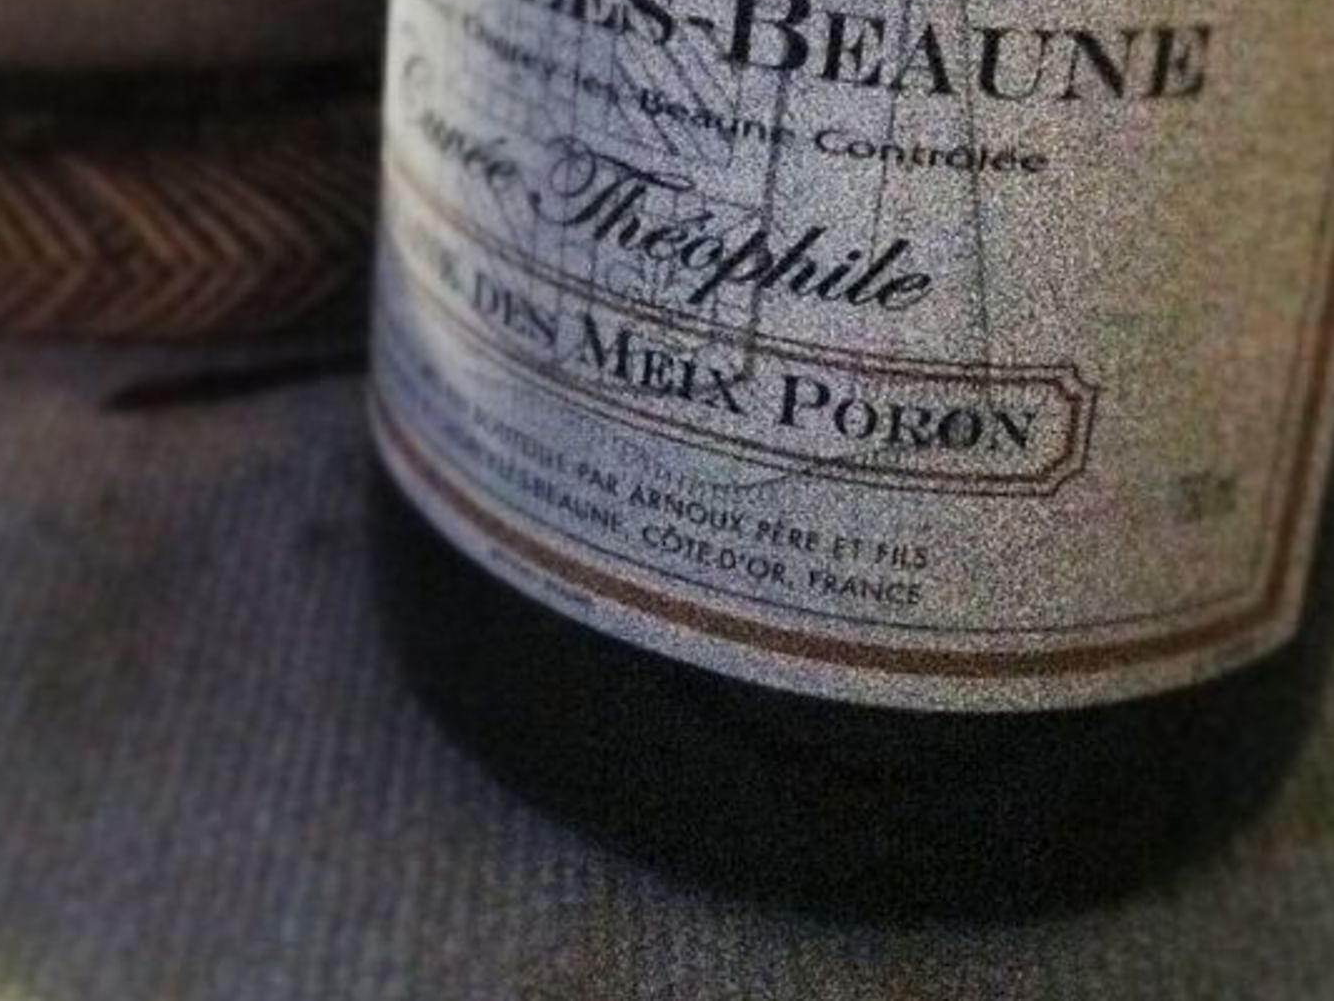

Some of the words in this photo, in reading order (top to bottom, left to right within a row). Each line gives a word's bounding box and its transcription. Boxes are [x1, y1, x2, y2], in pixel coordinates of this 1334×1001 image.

[528, 135, 933, 312] Théophile
[564, 311, 755, 415] MEIX
[778, 374, 1039, 451] PORON
[629, 483, 745, 533] ARNOUX
[755, 511, 820, 552] PÈRE
[832, 535, 864, 562] ET
[874, 541, 930, 572] FILS
[808, 567, 925, 607] FRANCE
